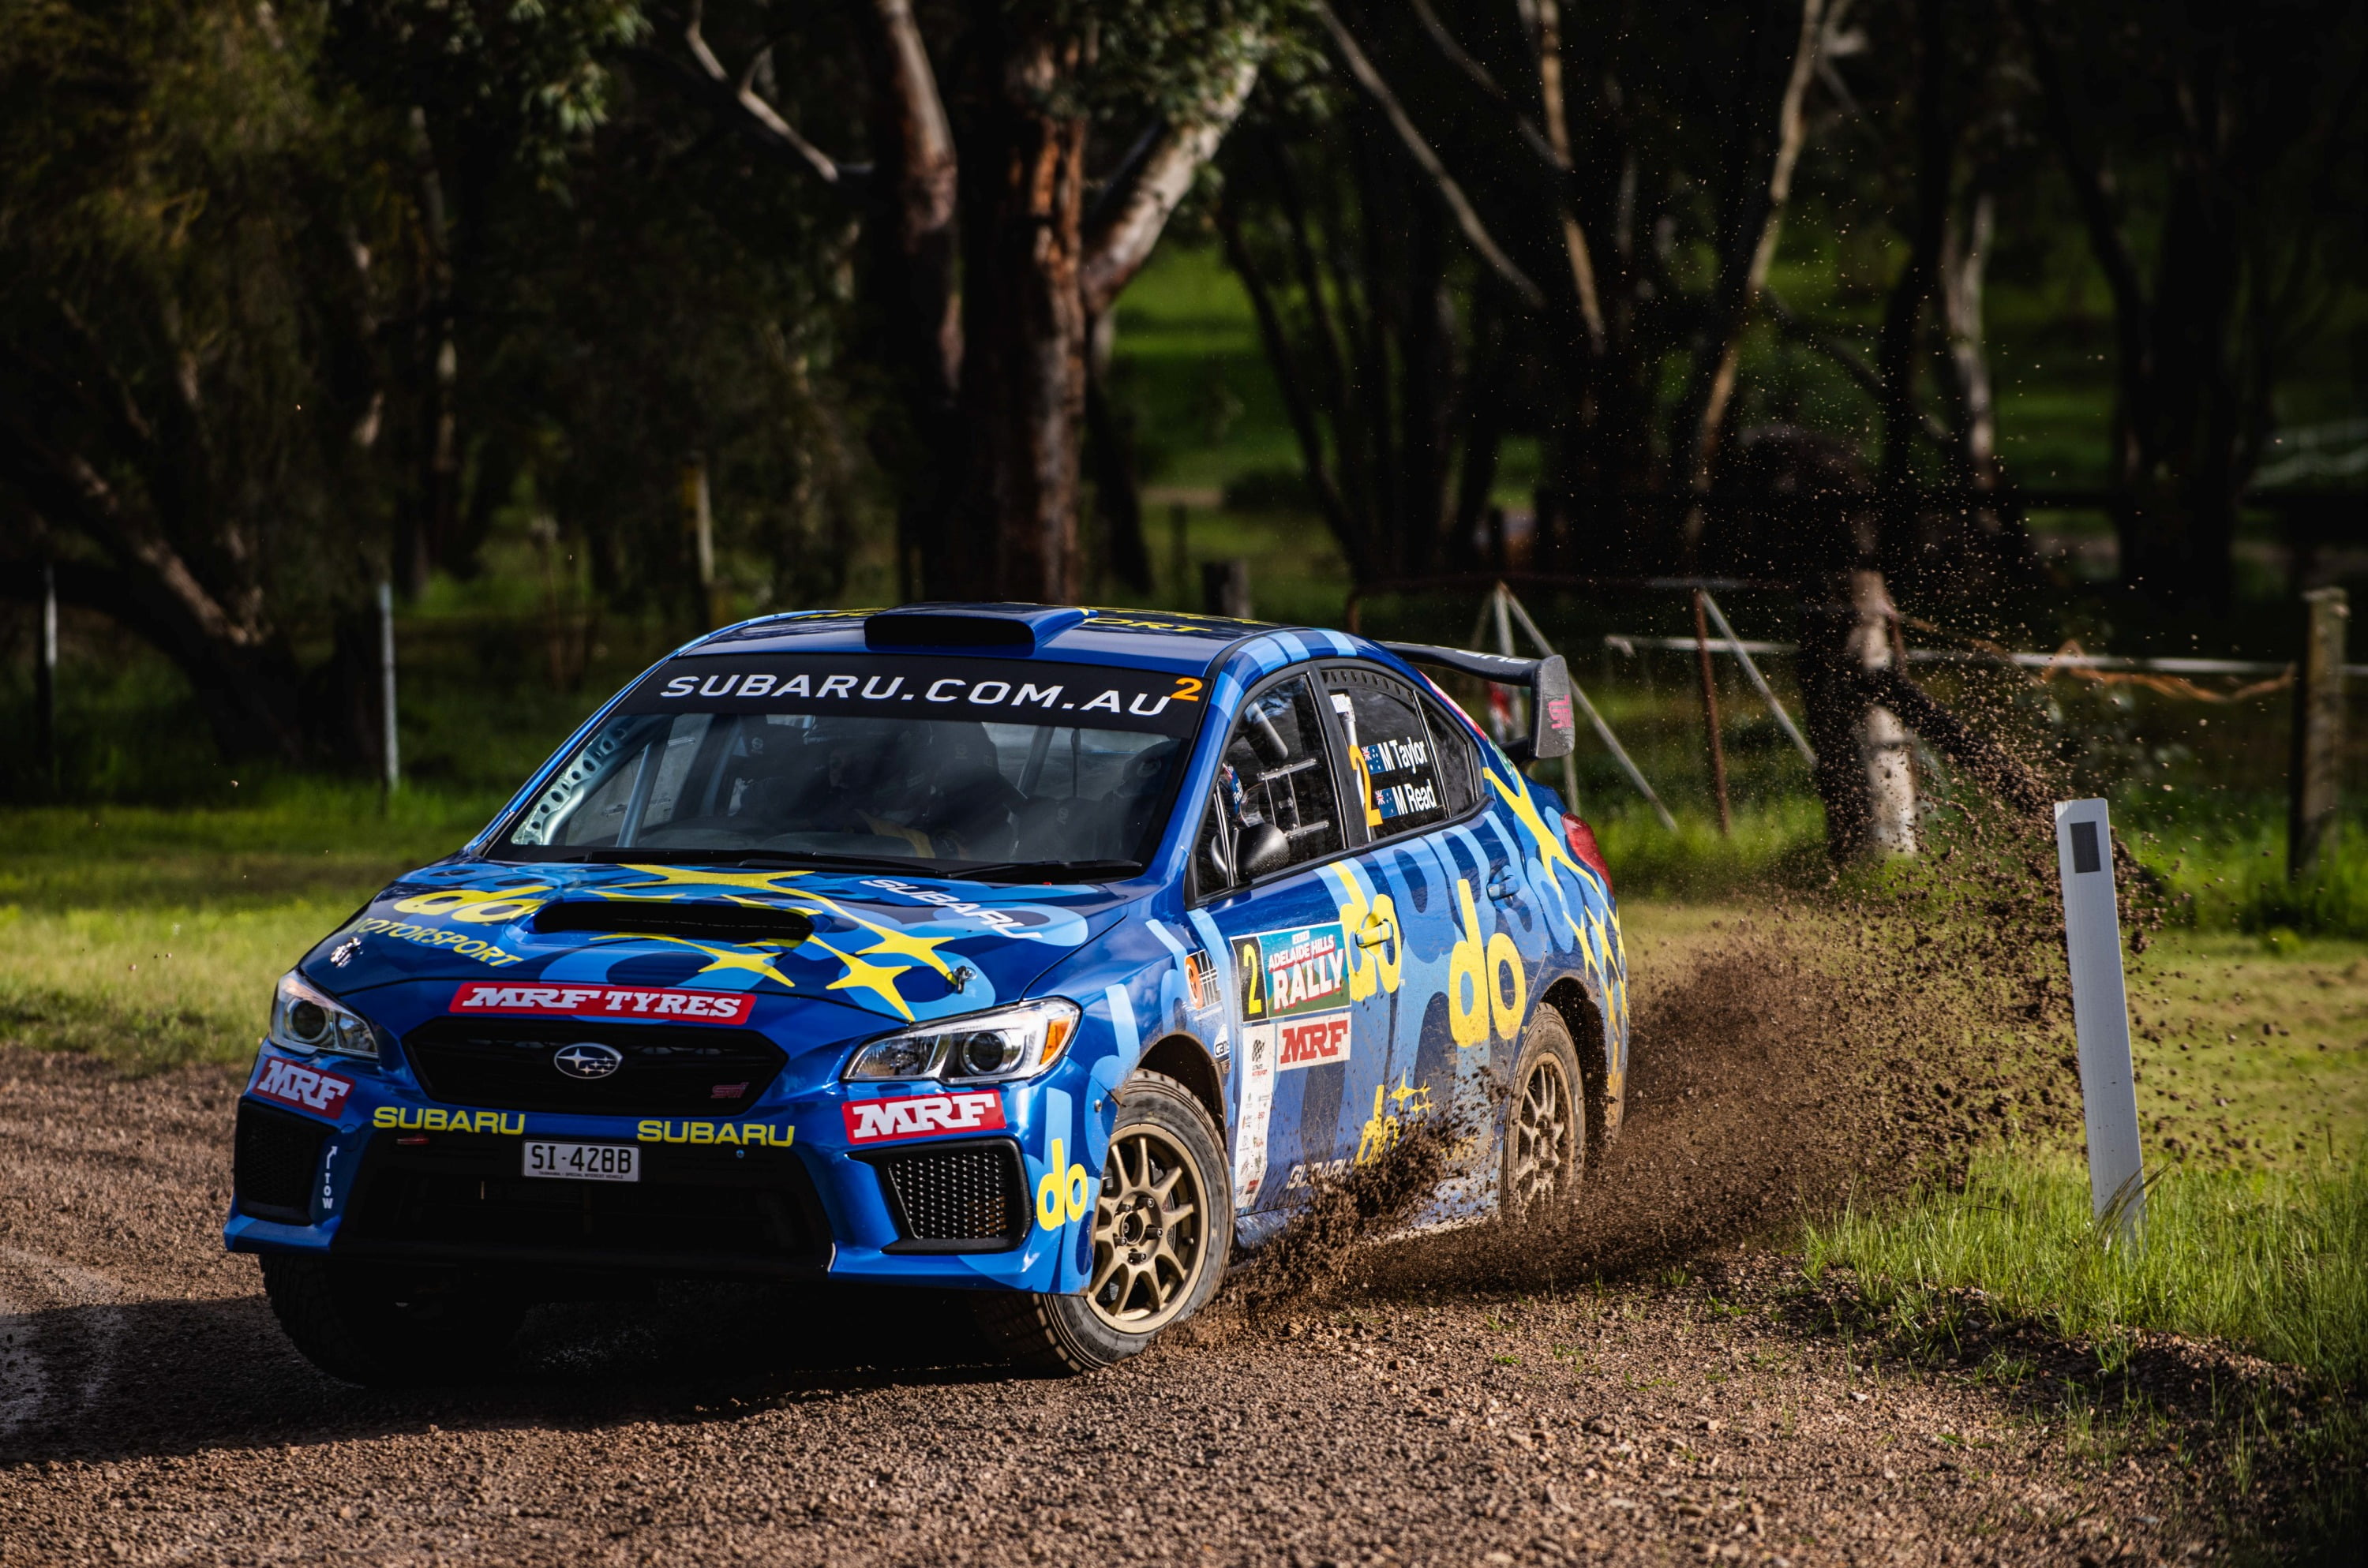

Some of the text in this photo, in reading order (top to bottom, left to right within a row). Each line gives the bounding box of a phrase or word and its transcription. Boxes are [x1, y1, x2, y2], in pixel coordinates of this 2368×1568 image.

[661, 674, 1203, 716] SUBARU.COM.AU 2
[1377, 736, 1427, 773] M Taylor
[1348, 744, 1383, 827] 2
[1392, 778, 1437, 815] M Read
[394, 885, 554, 922] do
[860, 879, 1043, 938] SUBARU
[1268, 934, 1335, 971] ADELAIDE HILLS
[1328, 862, 1402, 1002] do
[1243, 943, 1262, 1015] 2
[1272, 949, 1345, 1011] RALLY
[1448, 878, 1527, 1048] do
[462, 988, 741, 1017] MRF TYRES
[1280, 1020, 1348, 1065] MRF
[257, 1060, 350, 1110] MRF
[373, 1106, 525, 1135] SUBARU
[637, 1121, 795, 1147] SUBARU
[852, 1094, 996, 1139] MRF
[322, 1173, 333, 1209] TOW
[1036, 1138, 1088, 1231] do
